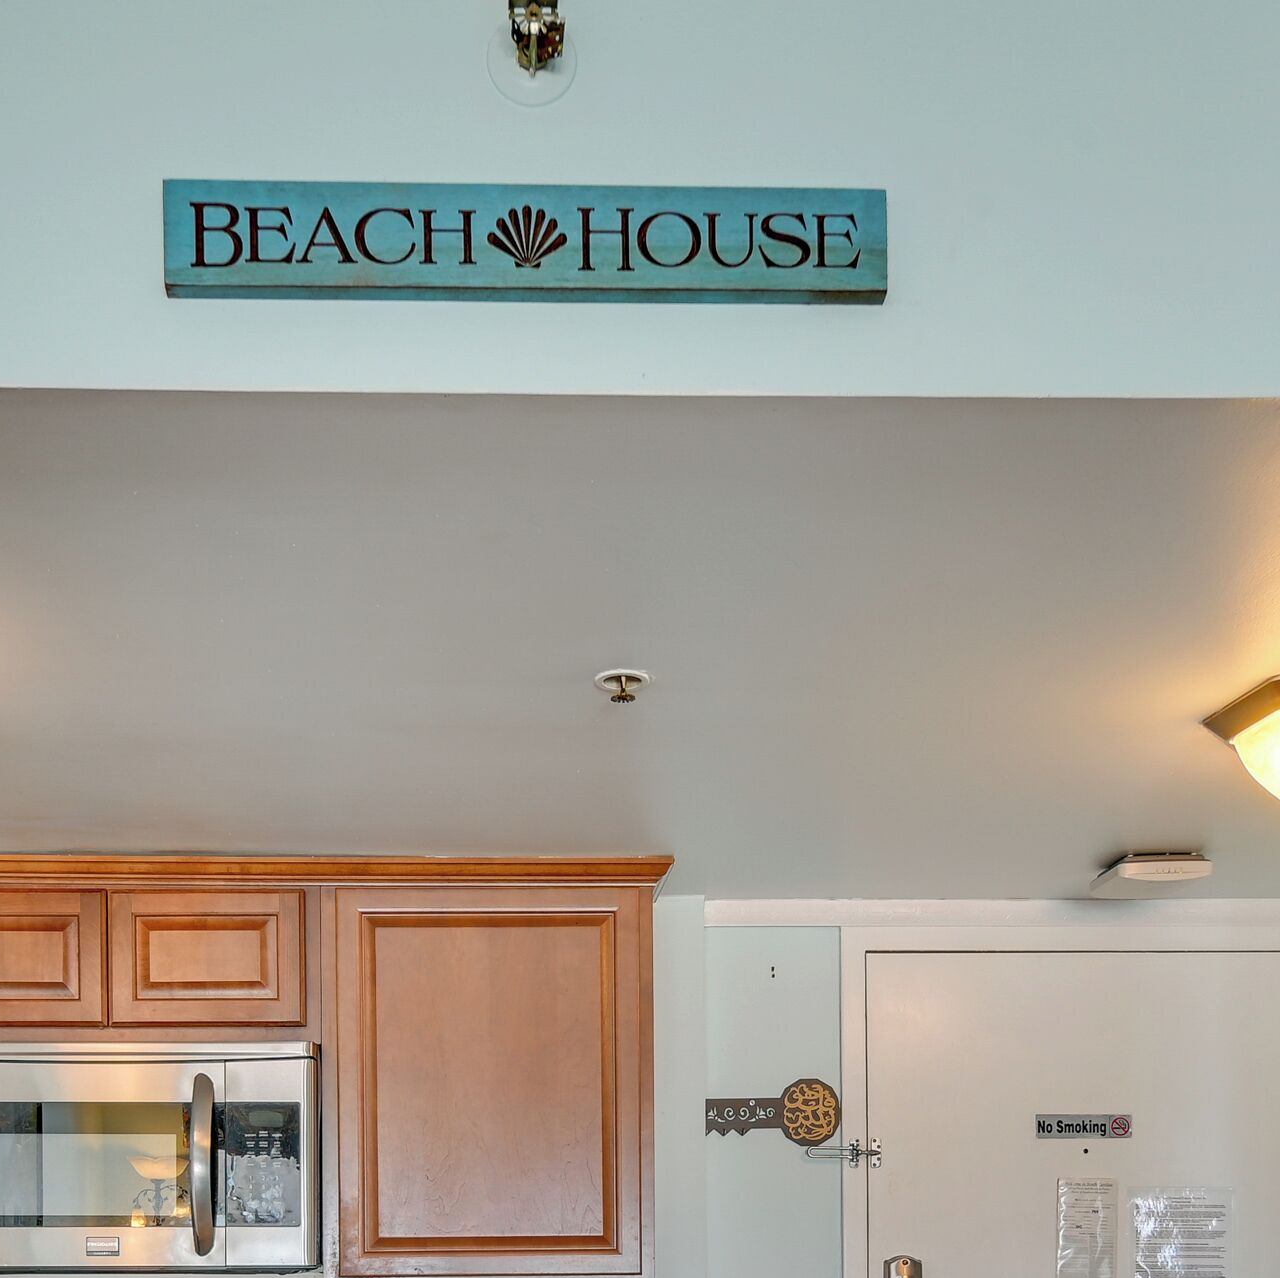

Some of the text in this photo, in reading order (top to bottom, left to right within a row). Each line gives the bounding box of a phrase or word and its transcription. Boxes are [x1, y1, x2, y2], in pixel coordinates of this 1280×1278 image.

[189, 200, 861, 273] BEACH HOUSE
[1037, 1120, 1107, 1136] No Smoking
